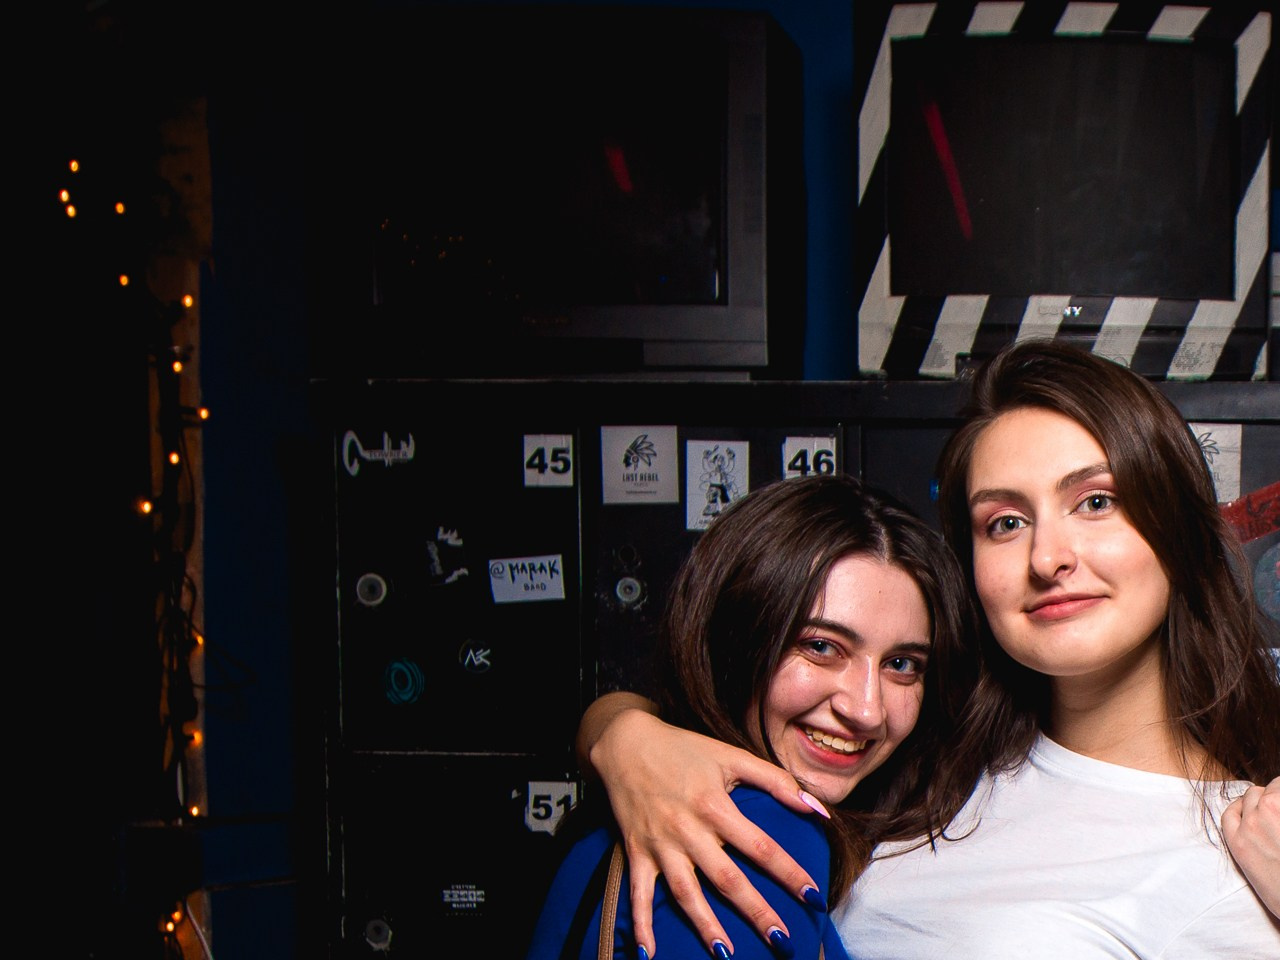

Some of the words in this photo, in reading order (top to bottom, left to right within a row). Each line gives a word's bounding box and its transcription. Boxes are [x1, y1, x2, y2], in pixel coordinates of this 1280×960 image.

[526, 446, 571, 474] 45
[788, 448, 835, 476] 46
[532, 794, 571, 820] 51
